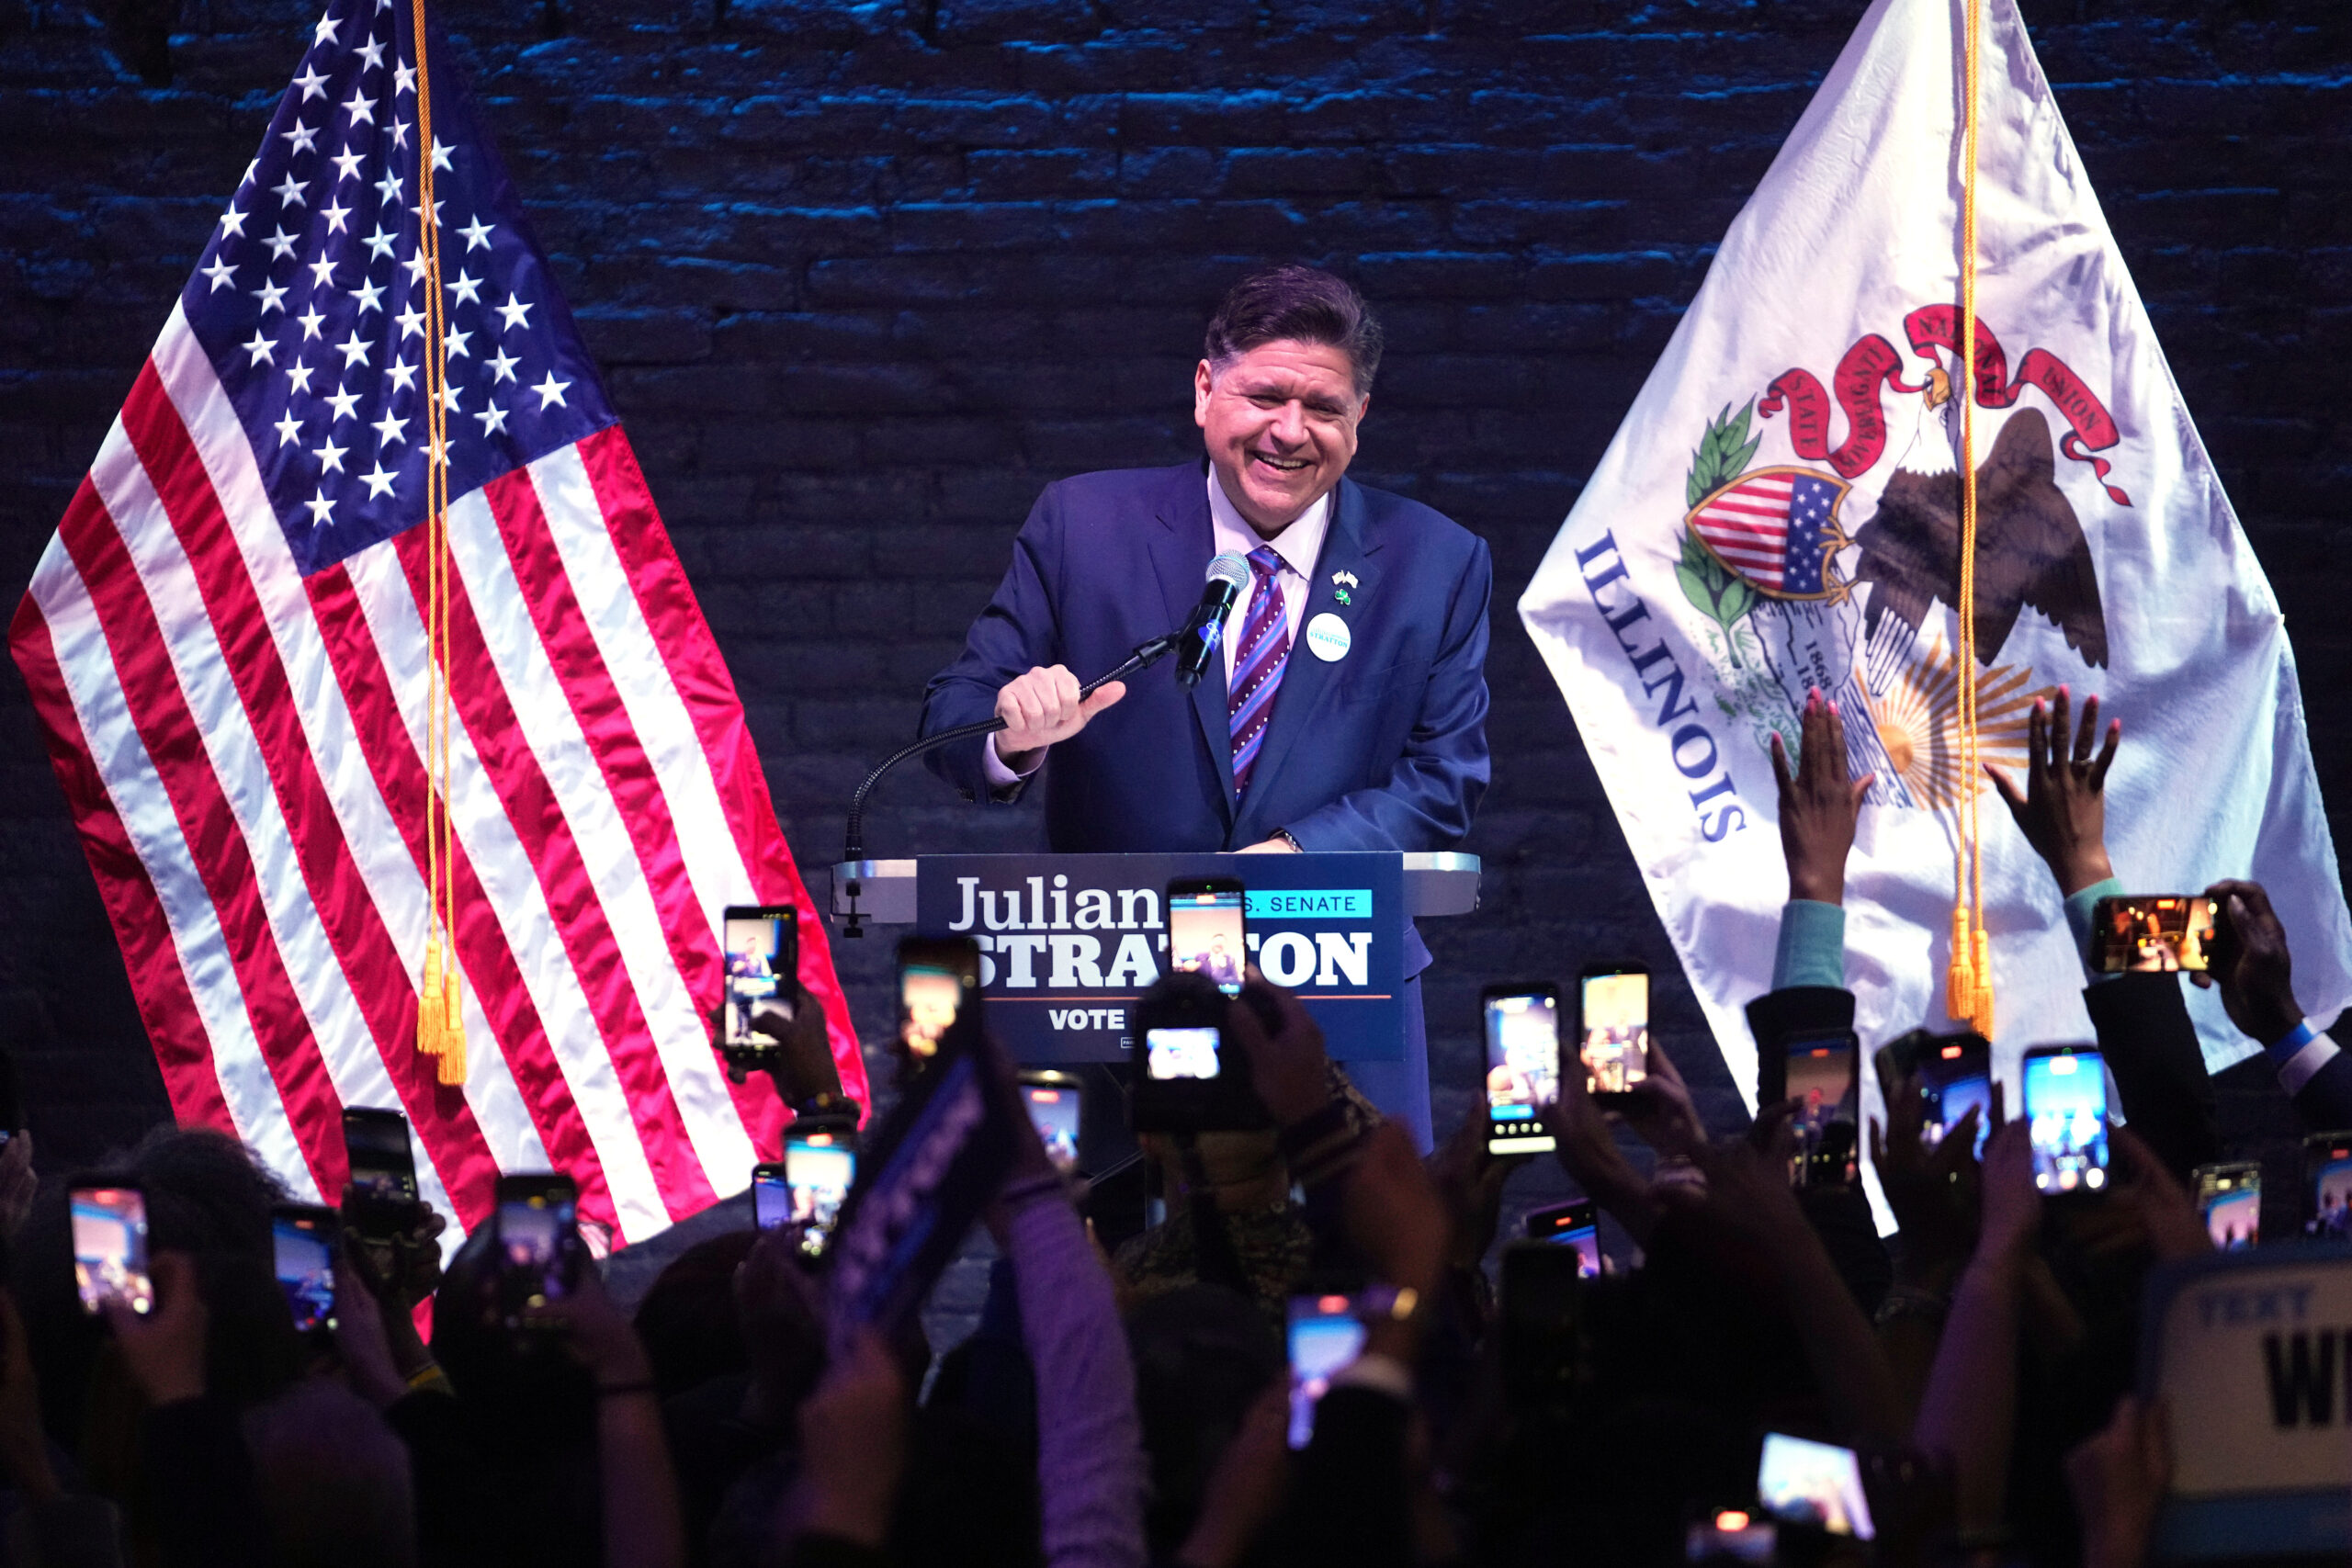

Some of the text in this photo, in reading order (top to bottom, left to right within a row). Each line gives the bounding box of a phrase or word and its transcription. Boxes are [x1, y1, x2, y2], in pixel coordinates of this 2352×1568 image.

[1917, 316, 2001, 399] NATONAL
[1790, 375, 1817, 448] STATE
[2042, 367, 2101, 431] UNION
[1574, 527, 1747, 843] ILLINOIS
[1805, 641, 1832, 690] 1868
[949, 874, 1164, 931] Julian
[1271, 897, 1356, 912] SENATE
[969, 931, 1373, 988] TRAON
[1048, 1009, 1125, 1030] VOTE
[2199, 1284, 2312, 1325] TEXT
[2262, 1328, 2352, 1428] W
